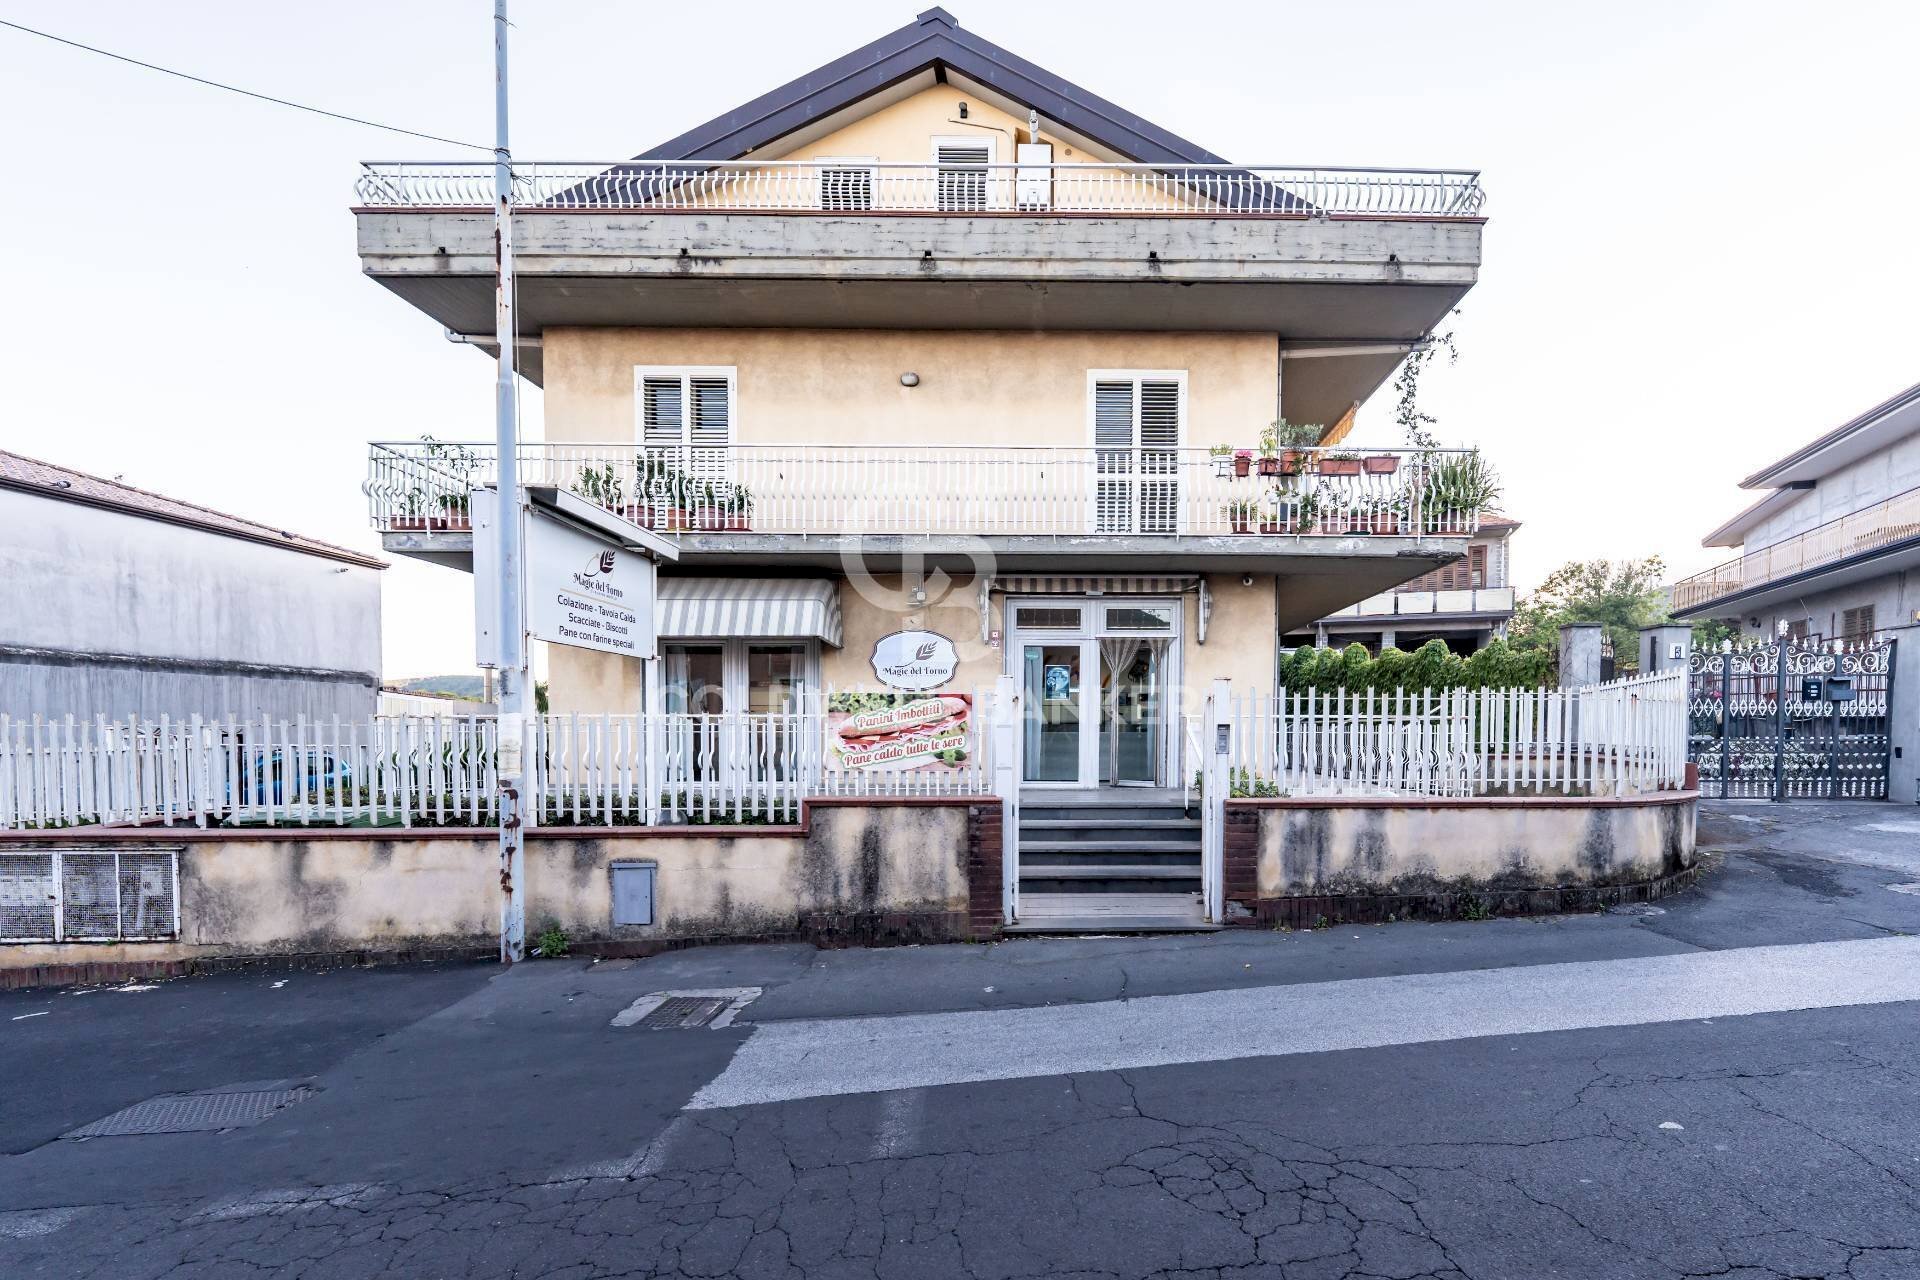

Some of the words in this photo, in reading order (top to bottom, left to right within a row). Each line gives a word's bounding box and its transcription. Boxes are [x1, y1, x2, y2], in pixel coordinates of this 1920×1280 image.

[573, 572, 595, 590] Magie
[596, 580, 605, 593] del
[606, 583, 624, 598] Forno
[558, 594, 593, 612] Colazione
[598, 605, 619, 619] Tavola
[619, 611, 636, 624] Calda
[568, 612, 600, 629] Scacciate
[605, 621, 628, 635] Biscotti
[558, 625, 578, 638] Pane
[579, 632, 592, 641] con
[592, 632, 612, 645] farine
[612, 640, 635, 650] speciali
[882, 666, 909, 677] Magie
[910, 666, 922, 675] del
[923, 666, 948, 675] Forno
[857, 711, 893, 728] Panini
[894, 703, 941, 721] Imbottiti
[844, 754, 872, 767] Pane
[874, 745, 903, 760] caldo
[906, 743, 929, 756] tutte
[931, 741, 940, 750] le
[942, 736, 963, 748] sere
